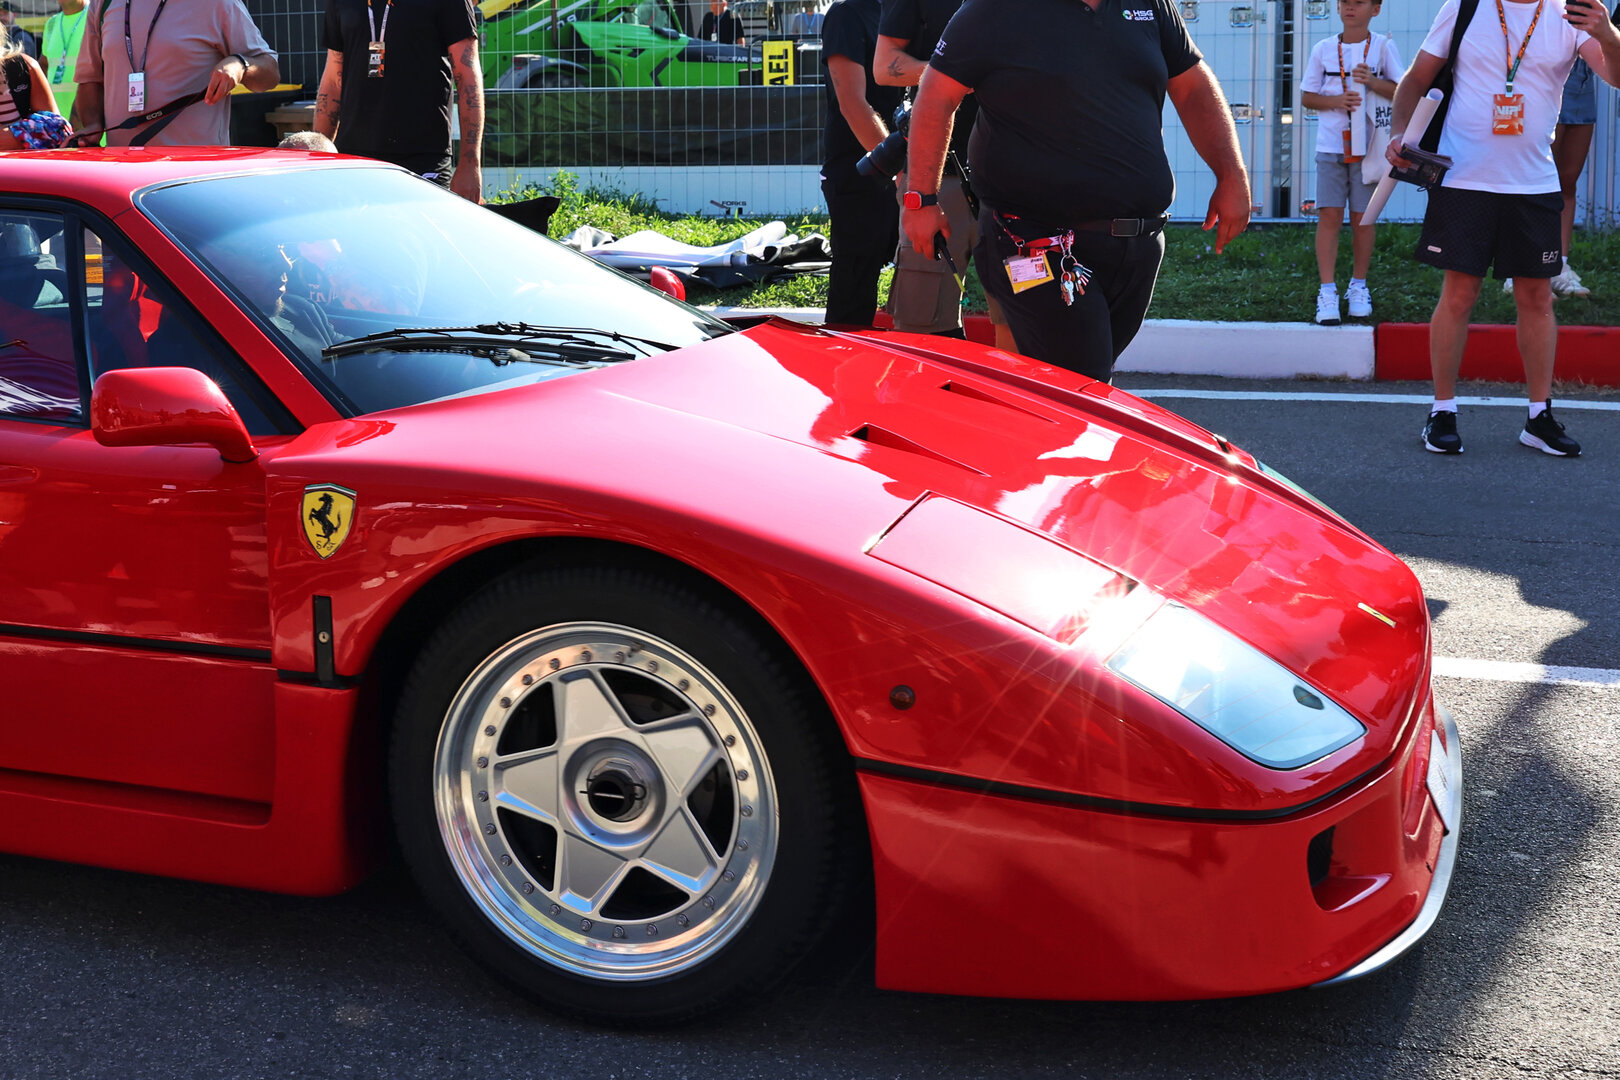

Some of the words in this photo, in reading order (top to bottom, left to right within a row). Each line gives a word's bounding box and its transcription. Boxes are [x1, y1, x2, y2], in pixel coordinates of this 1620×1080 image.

[1132, 9, 1154, 17] HSG
[146, 110, 163, 121] EOS
[1496, 105, 1519, 116] VIP
[1542, 250, 1559, 261] EA7
